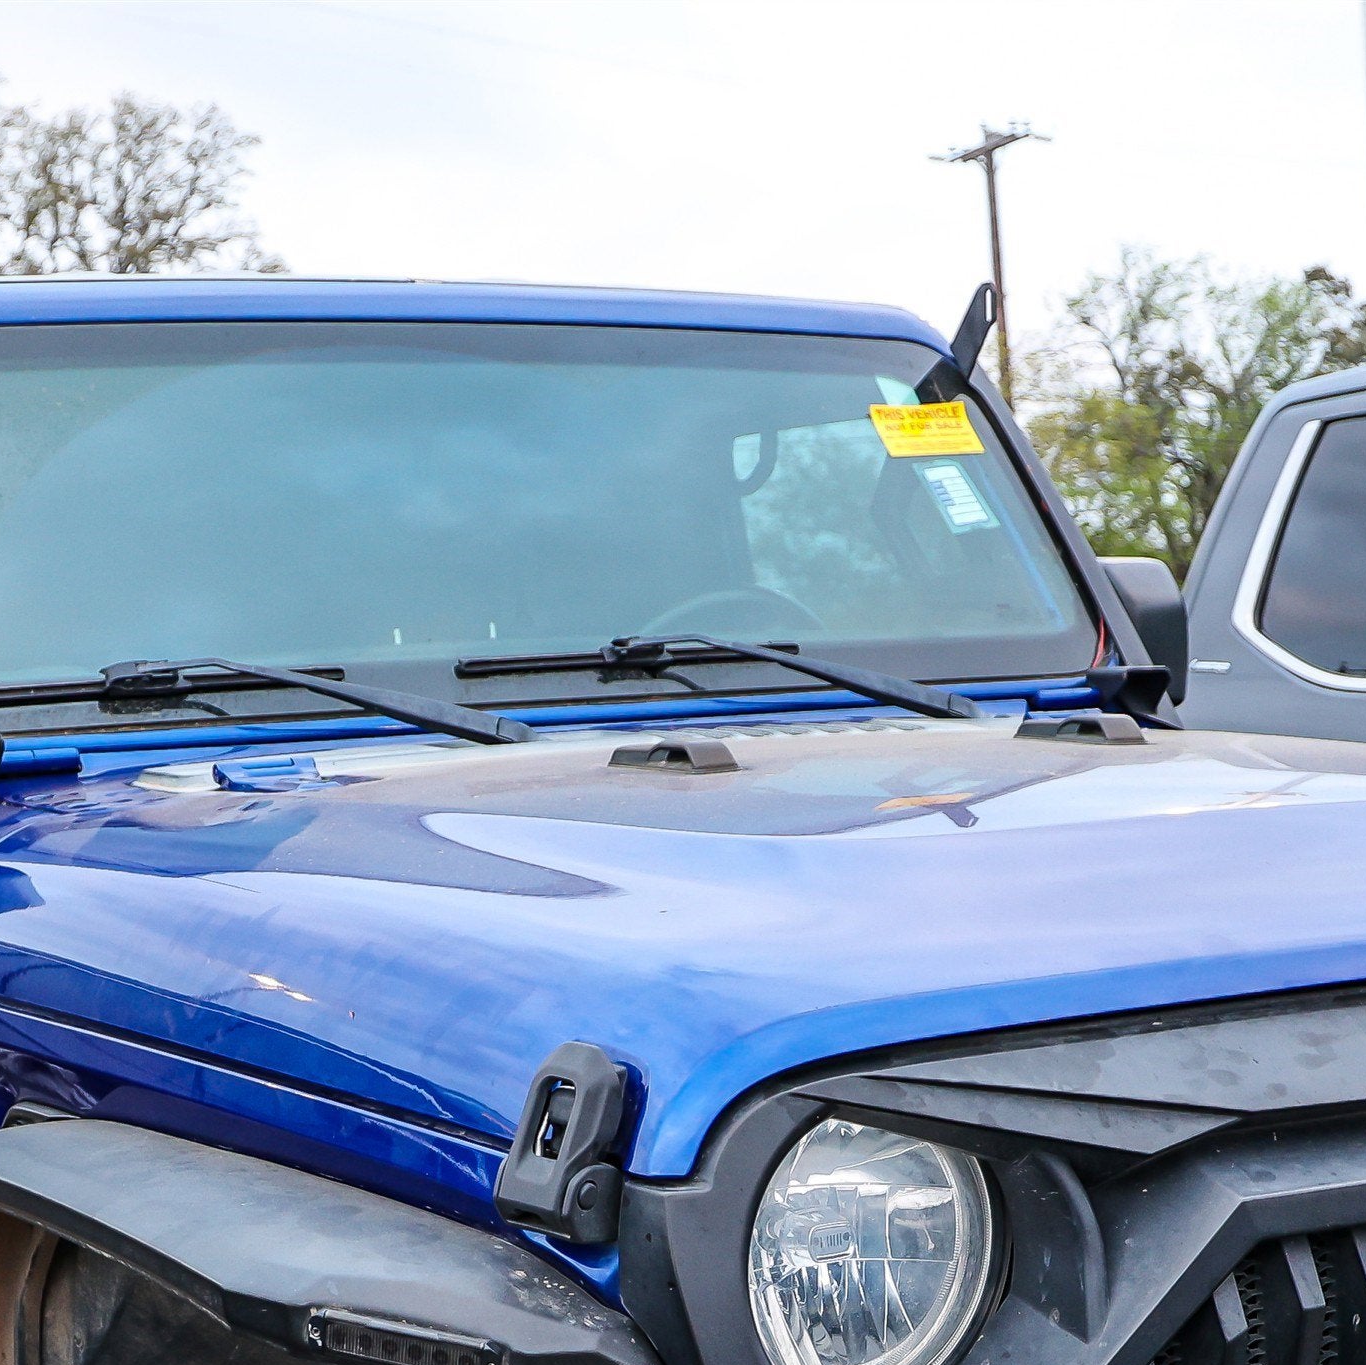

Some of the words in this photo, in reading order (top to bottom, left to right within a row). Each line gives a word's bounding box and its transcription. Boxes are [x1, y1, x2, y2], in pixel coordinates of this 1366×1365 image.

[875, 408, 906, 420] THIS
[907, 405, 961, 419] VEHICLE
[885, 422, 906, 431] NOT
[909, 421, 932, 430] FOR
[935, 420, 963, 429] SALE
